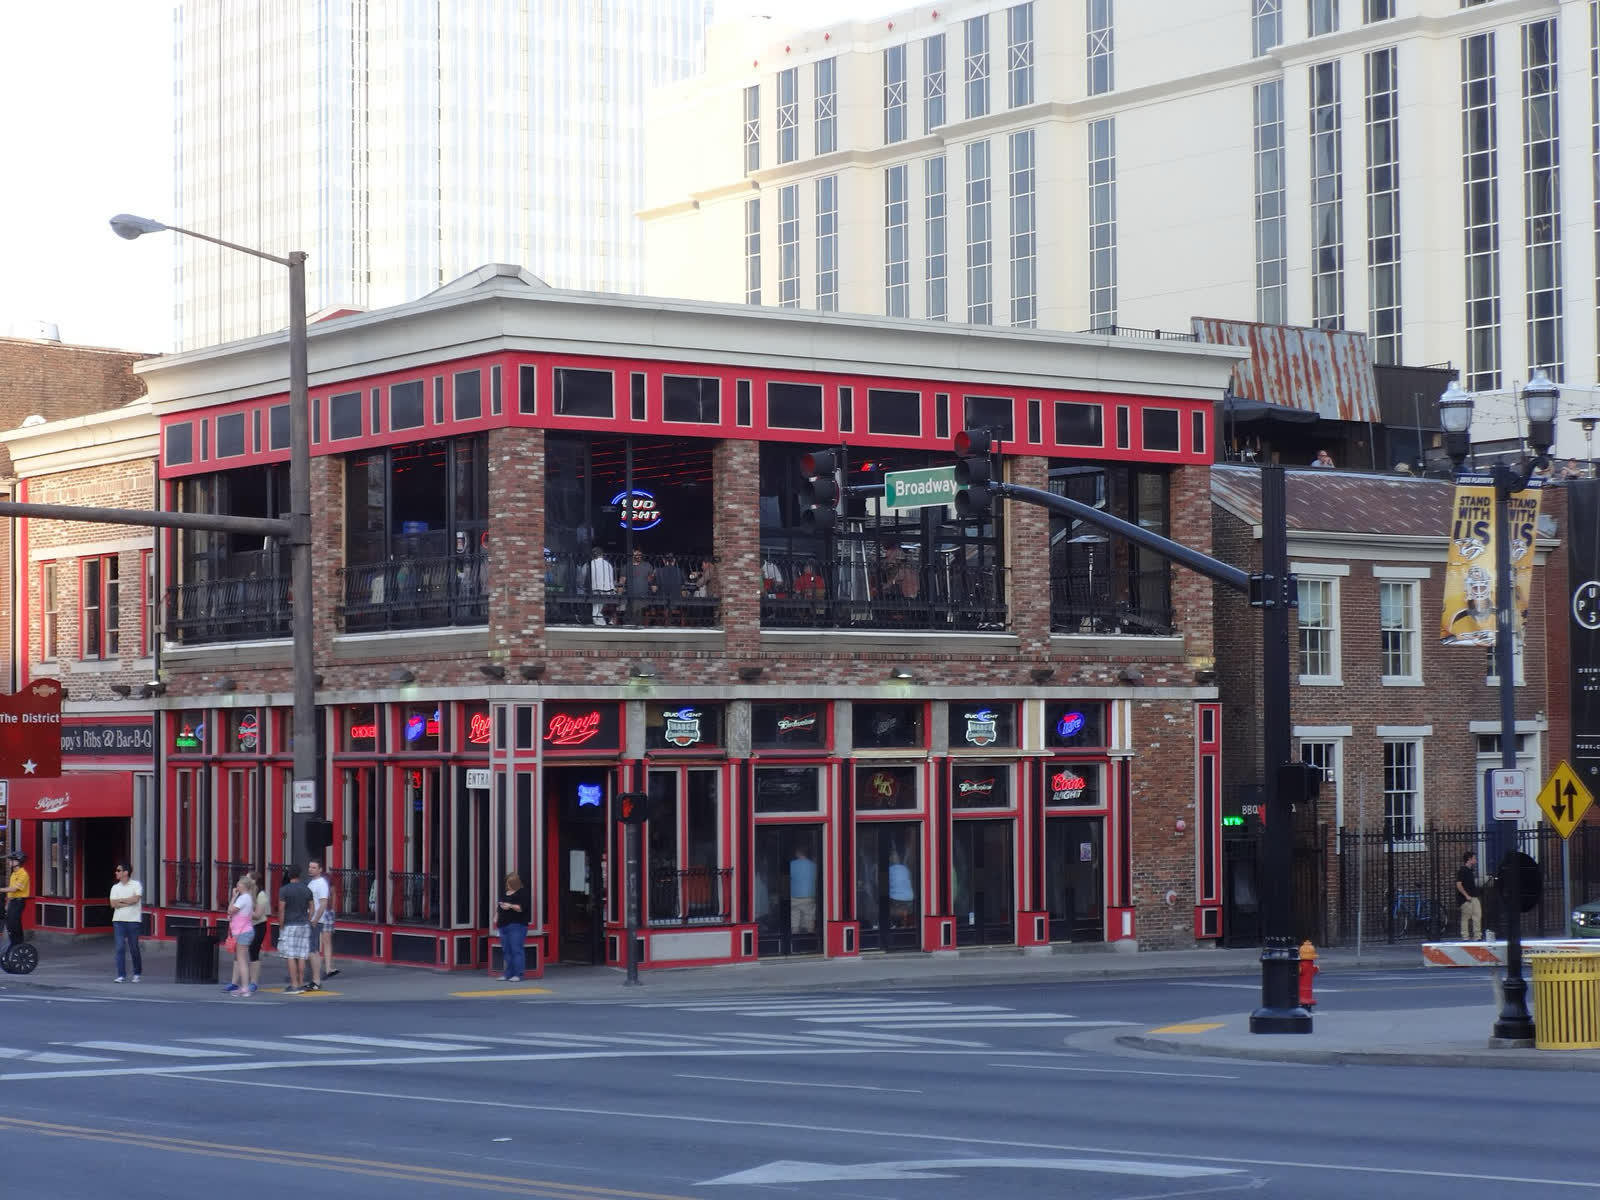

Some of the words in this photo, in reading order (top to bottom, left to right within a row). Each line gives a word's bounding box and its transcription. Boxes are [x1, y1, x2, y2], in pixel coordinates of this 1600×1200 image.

[895, 477, 957, 497] Broadway
[1460, 496, 1490, 506] STAND
[1508, 498, 1537, 509] STAND
[1458, 508, 1490, 520] WITH
[1453, 520, 1490, 545] US
[0, 713, 18, 723] The
[22, 713, 60, 723] District
[544, 711, 600, 745] Rippy's
[61, 730, 81, 750] ppy's
[83, 730, 101, 748] Ribs
[102, 730, 114, 747] &
[116, 729, 152, 748] Bar-B-Q
[1053, 773, 1086, 791] Coors
[1504, 777, 1514, 785] NO
[1053, 790, 1083, 801] LIGHT
[1496, 789, 1523, 798] VENDING
[1241, 804, 1259, 815] BBQ
